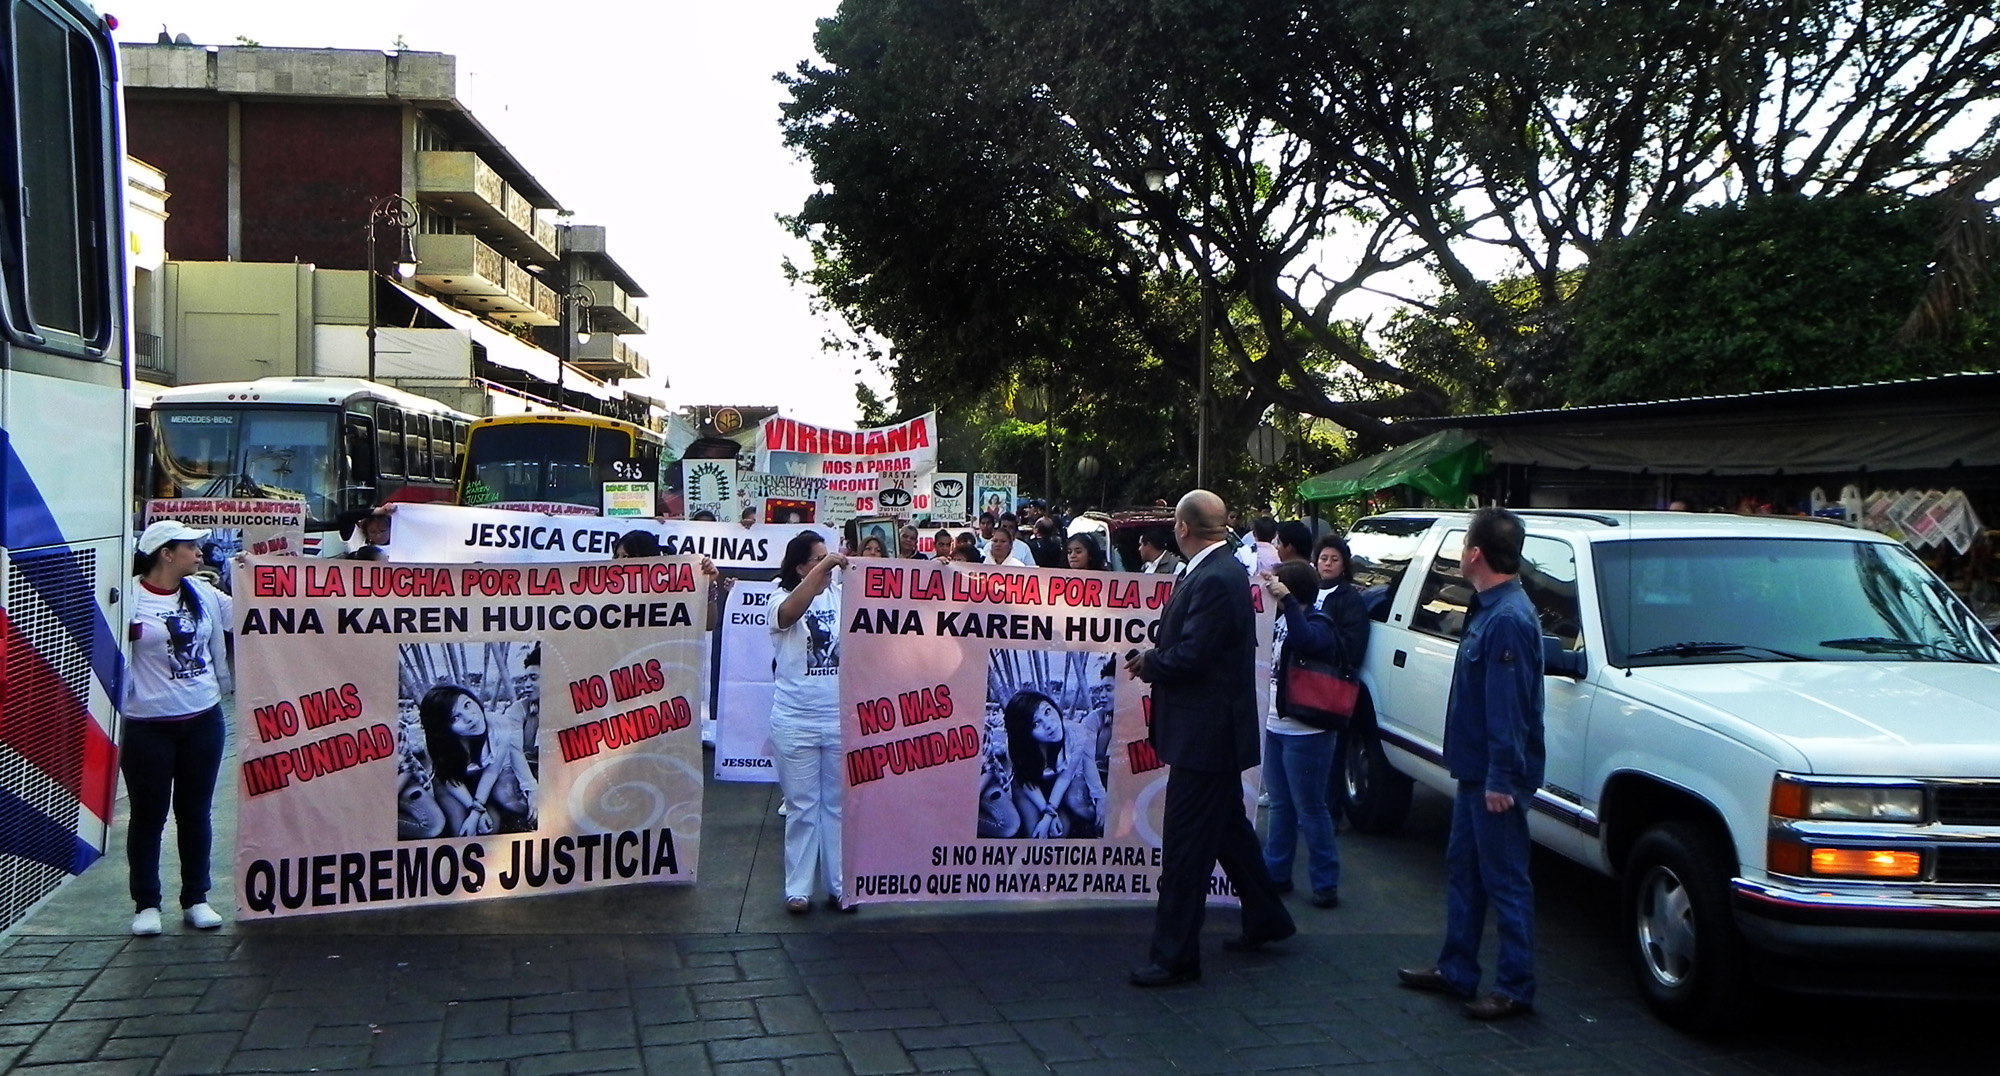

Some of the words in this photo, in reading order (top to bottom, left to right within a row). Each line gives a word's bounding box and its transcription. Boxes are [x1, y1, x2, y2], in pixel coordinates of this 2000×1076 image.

[765, 417, 930, 455] VIRIDIANA
[855, 462, 865, 473] A
[868, 457, 911, 472] PARAR
[882, 471, 911, 479] BASTA
[893, 479, 905, 489] YA
[166, 502, 180, 513] LA
[181, 502, 214, 514] LUCHA
[215, 501, 236, 514] POR
[238, 502, 252, 514] LA
[253, 502, 301, 514] JUSTICIA
[182, 515, 218, 525] KAREN
[222, 515, 299, 527] HUICOCHEA
[465, 523, 566, 551] JESSICA
[668, 535, 768, 562] SALINAS
[253, 564, 297, 598] EN
[305, 564, 344, 598] LA
[353, 565, 455, 598] LUCHA
[461, 567, 521, 597] POR
[527, 566, 565, 596] LA
[569, 562, 696, 595] JUSTICIA
[864, 566, 904, 600] EN
[910, 568, 946, 601] LA
[952, 570, 1042, 606] LUCHA
[1048, 575, 1104, 608] POR
[1107, 578, 1144, 610] LA
[241, 605, 325, 636] ANA
[337, 605, 470, 635] KAREN
[482, 601, 692, 633] HUICOCHEA
[731, 613, 767, 626] EXIG
[849, 607, 924, 636] ANA
[936, 610, 1054, 641] KAREN
[568, 673, 608, 715] NO
[610, 658, 666, 700] MAS
[805, 667, 838, 676] Justici
[252, 697, 299, 743] NO
[299, 682, 363, 729] MAS
[856, 697, 897, 736] NO
[899, 684, 954, 728] MAS
[556, 695, 692, 764] IMPUNIDAD
[242, 727, 395, 797] IMPUNIDAD
[722, 758, 773, 768] JESSICA
[846, 724, 980, 788] IMPUNIDAD
[244, 841, 487, 916] QUEREMOS
[498, 827, 679, 891] JUSTICIA
[931, 845, 949, 867] SI
[953, 845, 978, 867] NO
[981, 845, 1019, 867] HAY
[1021, 845, 1097, 867] JUSTICIA
[1101, 846, 1146, 867] PARA
[855, 873, 922, 896] PUEBLO
[926, 873, 962, 897] QUE
[965, 873, 991, 895] NO
[995, 873, 1044, 894] HAYA
[1046, 872, 1079, 894] PAZ
[1082, 873, 1127, 894] PARA
[1131, 873, 1152, 894] EL
